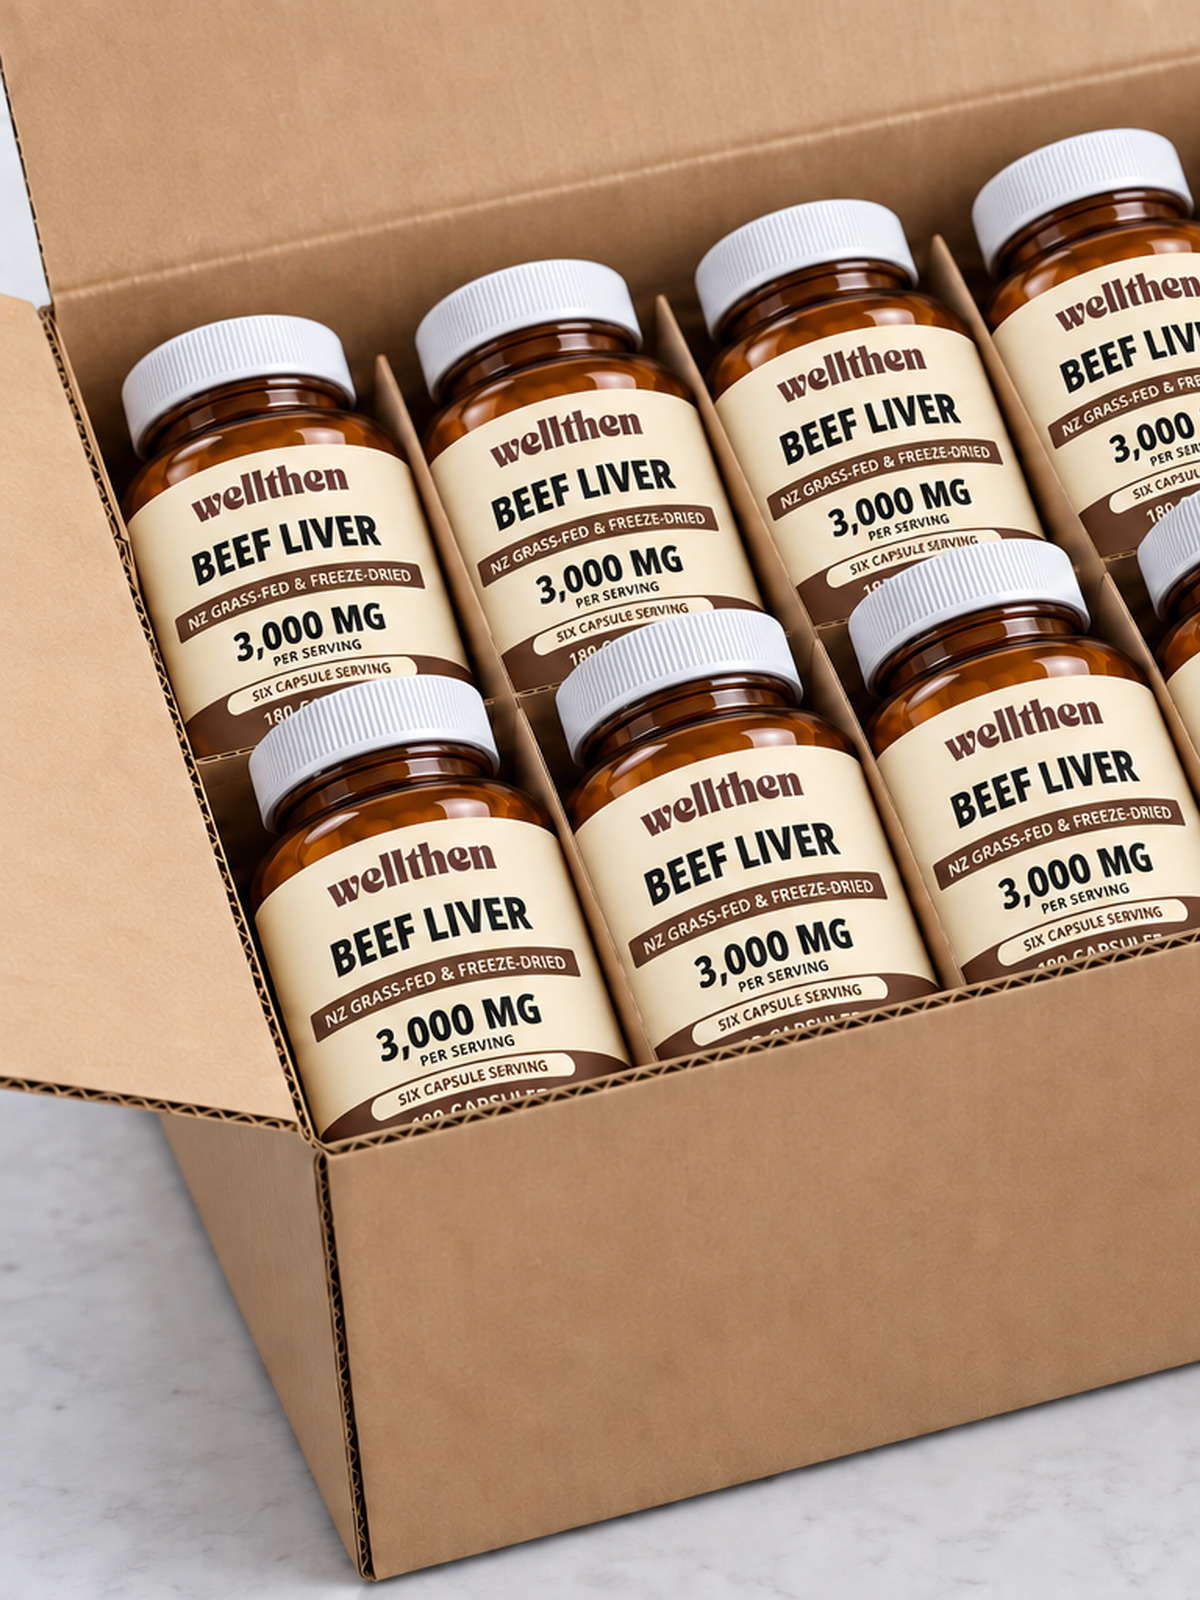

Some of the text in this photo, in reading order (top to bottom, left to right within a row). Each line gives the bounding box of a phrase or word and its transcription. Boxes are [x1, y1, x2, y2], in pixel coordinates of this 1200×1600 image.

[777, 346, 926, 402] wellthen
[1060, 335, 1136, 393] BEEF
[780, 394, 961, 465] BEEF LIVER
[1062, 382, 1174, 436] NZ GRASS-FED &
[1110, 412, 1194, 462] 3,000
[490, 410, 643, 468] wellthen
[1150, 451, 1173, 466] PER
[192, 465, 349, 522] wellthen
[492, 460, 676, 531] BEEF LIVER
[781, 446, 990, 509] NZ GRASS-FED & FREEZE-DRIED
[1133, 484, 1153, 499] SIX
[828, 479, 972, 536] 3,000 MG
[868, 526, 891, 540] PER
[192, 516, 381, 586] BEEF LIVER
[491, 512, 705, 574] NZ GRASS-FED & FREEZE-DRIED
[850, 559, 870, 575] SIX
[188, 568, 411, 630] NZ GRASS-FED & FREEZE-DRIED
[536, 546, 683, 604] 3,000 MG
[576, 581, 659, 608] PER SERVING
[234, 603, 386, 661] 3,000 MG
[274, 639, 362, 666] PER SERVING
[557, 610, 633, 642] SIX CAPSULE
[252, 662, 391, 702] SIX CAPSULE SERVING
[944, 699, 1103, 761] wellthen
[640, 772, 804, 836] wellthen
[950, 750, 1140, 828] BEEF LIVER
[644, 823, 840, 906] BEEF LIVER
[948, 806, 1171, 877] NZ GRASS-FED & FREEZE-DRIED
[327, 842, 496, 907] wellthen
[998, 843, 1153, 909] 3,000 MG
[1042, 883, 1129, 914] PER SERVING
[330, 897, 533, 977] BEEF LIVER
[644, 880, 873, 954] NZ GRASS-FED & FREEZE-DRIED
[1024, 934, 1045, 952] SIX
[1048, 916, 1105, 941] CAPSULE
[1107, 906, 1162, 925] SERVING
[694, 918, 853, 988] 3,000 MG
[738, 960, 828, 992] PER SERVING
[326, 956, 566, 1028] NZ GRASS-FED & FREEZE-DRIED
[718, 1013, 740, 1031] SIX
[743, 994, 802, 1021] CAPSULE
[805, 984, 862, 1004] SERVING
[376, 994, 542, 1062] 3,000 MG
[420, 1034, 514, 1066] PER SERVING
[398, 1060, 548, 1106] SIX CAPSULE SERVING
